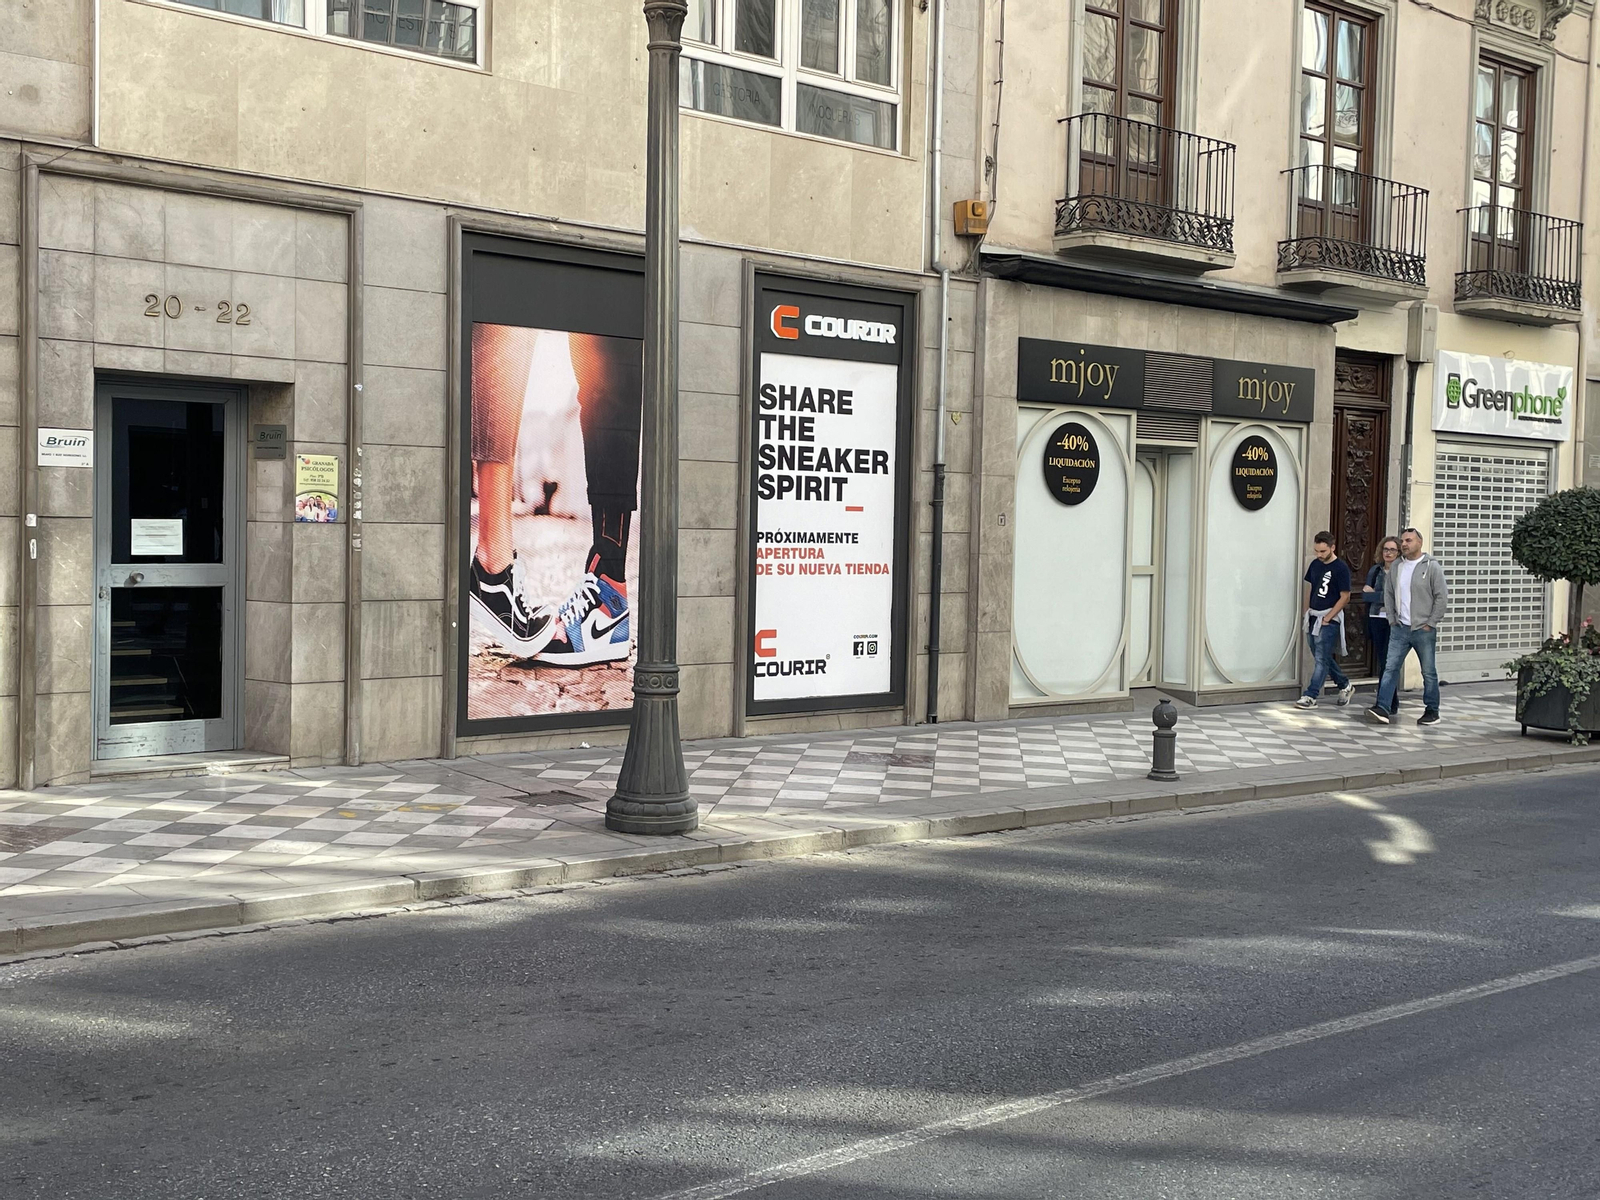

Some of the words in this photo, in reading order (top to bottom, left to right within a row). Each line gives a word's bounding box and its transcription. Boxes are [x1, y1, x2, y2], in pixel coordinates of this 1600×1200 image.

[809, 102, 861, 126] NOGUERAS
[144, 294, 184, 319] 20
[216, 300, 251, 326] 22
[804, 314, 897, 344] COURIR
[1049, 349, 1120, 400] mjoy
[759, 383, 853, 416] SHARE
[1237, 368, 1296, 414] mjoy
[1462, 378, 1564, 420] Greenphone
[260, 431, 282, 440] Bruin
[759, 413, 815, 442] THE
[46, 436, 87, 447] Bruin
[1056, 433, 1089, 451] -40%
[758, 443, 889, 475] SNEAKER
[1048, 456, 1096, 468] LIQUIDACIÓN
[1241, 445, 1269, 461] -40%
[300, 465, 335, 473] PSICÓLOGOS
[1235, 466, 1274, 477] LIQUIDACIÓN
[757, 473, 848, 502] SPIRIT
[757, 527, 859, 544] PRÓXIMAMENTE
[756, 547, 825, 559] APERTURA
[755, 563, 773, 575] DE
[776, 563, 795, 575] SU
[799, 563, 842, 575] NUEVA
[845, 563, 890, 575] TIENDA
[754, 659, 826, 677] COURIR
